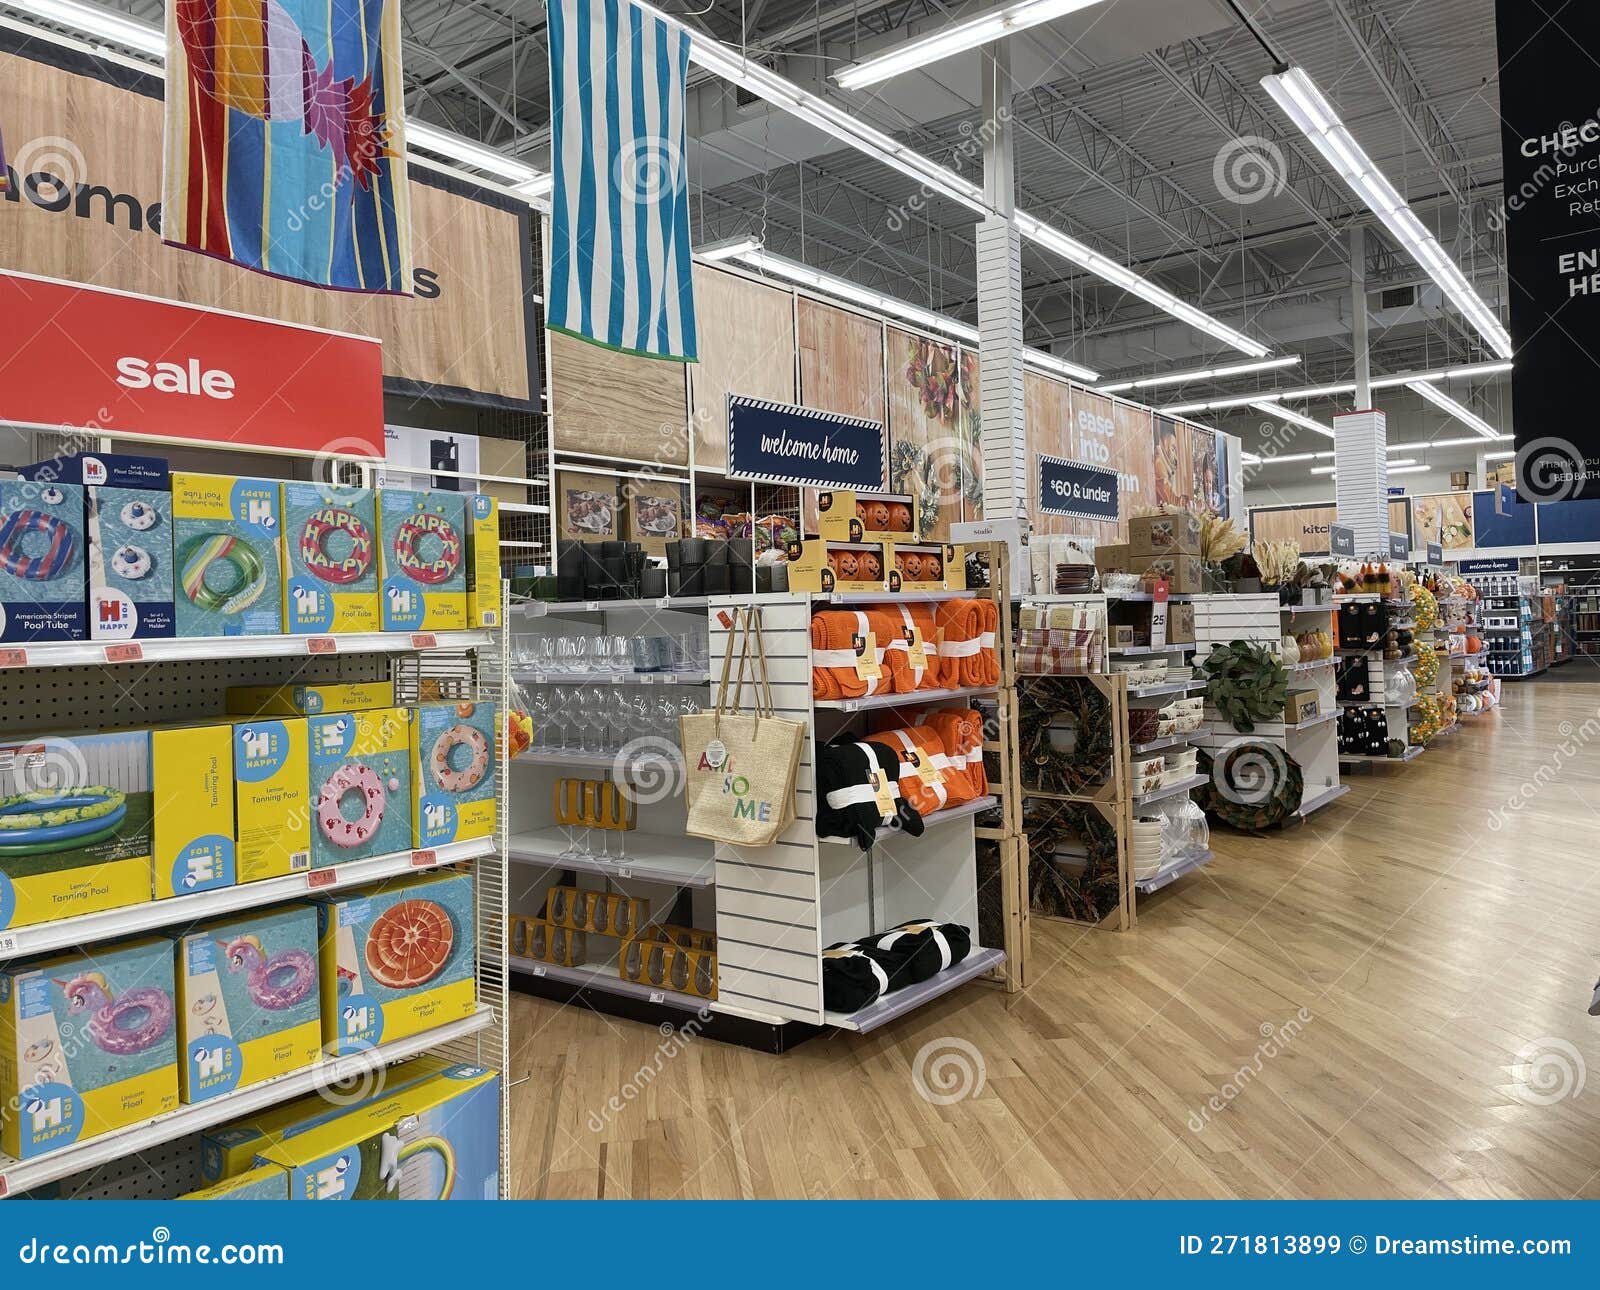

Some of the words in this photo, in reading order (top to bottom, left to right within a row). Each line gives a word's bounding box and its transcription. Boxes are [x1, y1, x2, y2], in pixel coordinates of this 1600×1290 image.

[1557, 155, 1600, 178] Purc
[116, 357, 236, 400] sale
[1078, 410, 1114, 438] ease
[760, 428, 822, 461] welcome
[822, 435, 859, 465] home
[1080, 431, 1110, 464] into
[1050, 479, 1071, 497] $60
[1073, 482, 1080, 498] &
[1082, 486, 1111, 503] under
[15, 612, 52, 620] Americana
[53, 612, 77, 621] Striped
[24, 620, 44, 629] Pool
[46, 620, 69, 629] Tube
[210, 756, 218, 774] Pool
[246, 758, 278, 769] HAPPY
[210, 775, 219, 808] Tanning
[252, 794, 281, 804] Tanning
[283, 791, 299, 800] Pool
[190, 846, 209, 856] FOR
[52, 891, 88, 903] Tanning
[90, 886, 109, 896] Pool
[70, 882, 92, 890] Lemon
[199, 1072, 232, 1089] HAPPY
[122, 1098, 143, 1111] Float
[32, 1124, 73, 1144] HAPPY
